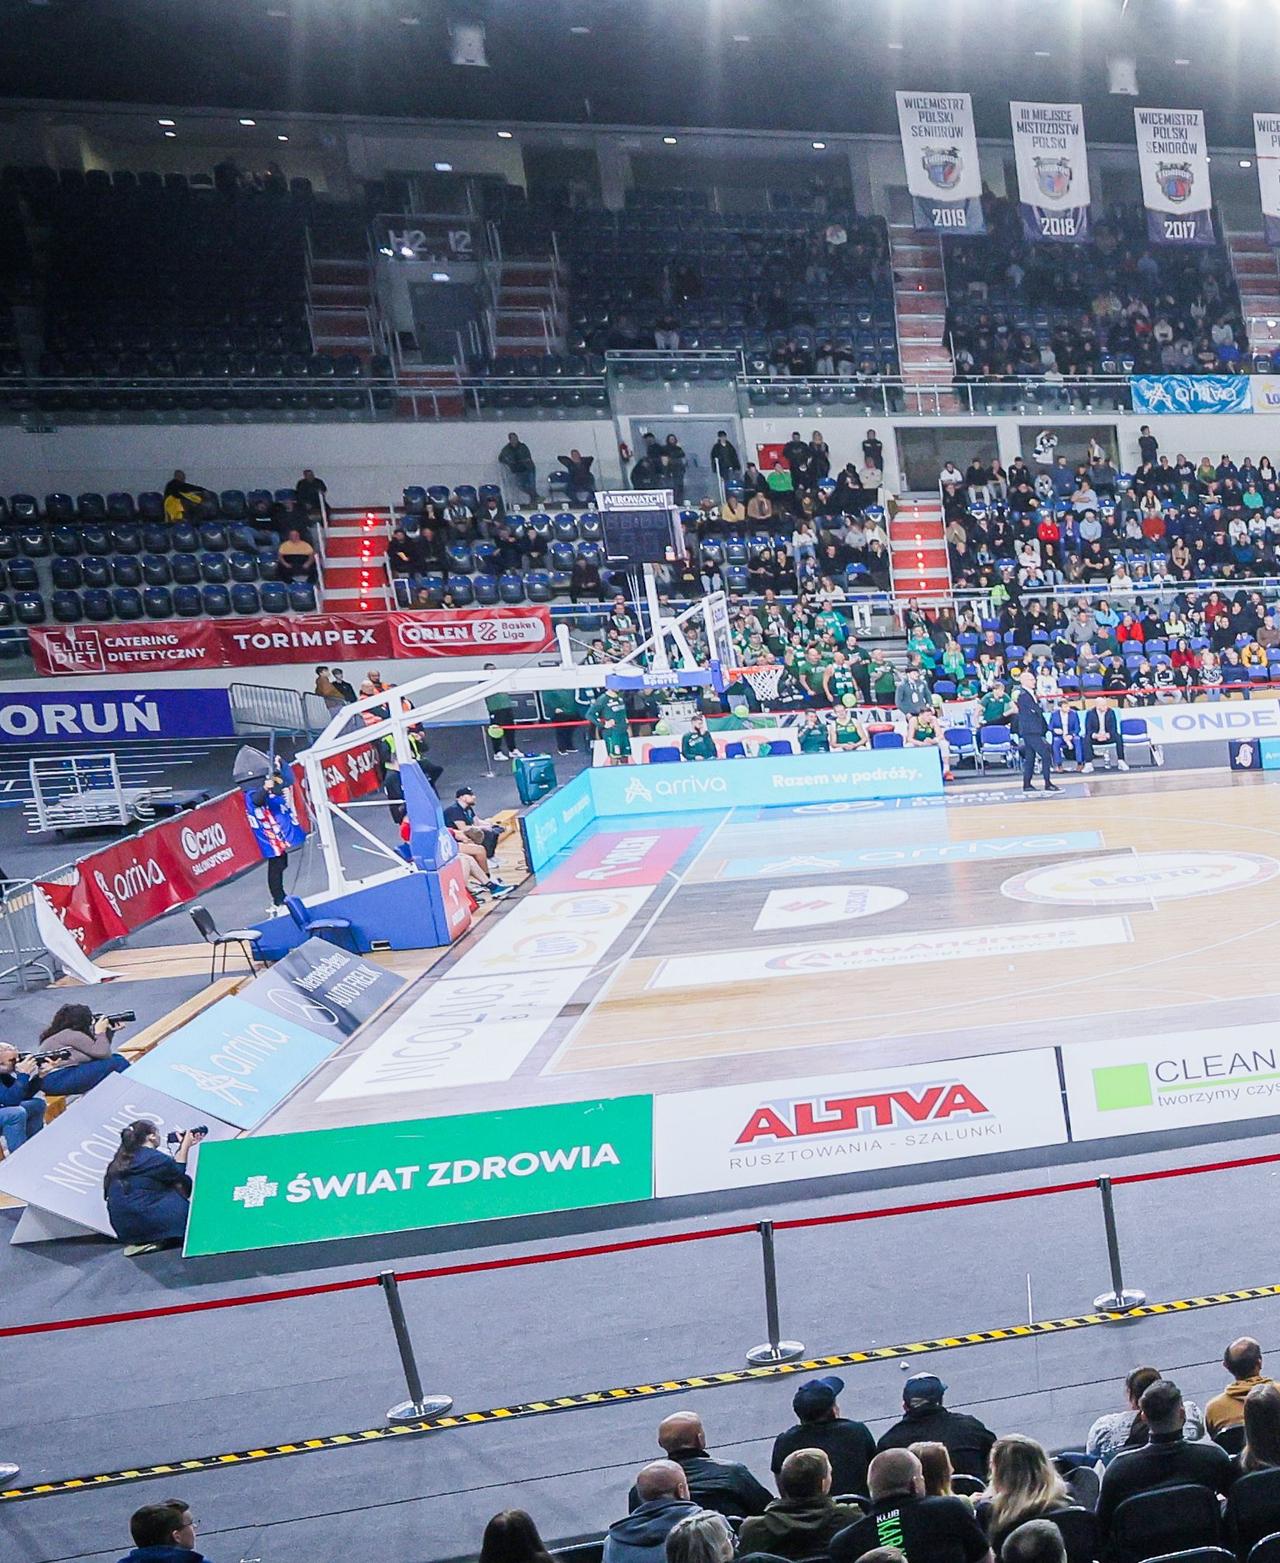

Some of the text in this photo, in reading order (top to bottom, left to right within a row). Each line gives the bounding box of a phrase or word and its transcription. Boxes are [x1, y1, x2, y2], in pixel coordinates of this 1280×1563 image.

[904, 98, 965, 110] WICEMISTRZ
[919, 110, 954, 123] POLSKI
[1021, 109, 1072, 121] III MIEJSCE
[1139, 112, 1199, 126] WICEMISTRZ
[1153, 126, 1188, 140] POLSKI
[1032, 136, 1067, 149] POLSKI
[1146, 140, 1198, 155] SENIORÓW
[932, 208, 966, 227] 2019
[1040, 217, 1077, 235] 2018
[1164, 221, 1196, 239] 2017
[405, 626, 469, 642] ORLEN
[501, 622, 537, 632] Basket
[502, 631, 525, 639] Liga
[52, 640, 96, 653] ELITE
[104, 634, 179, 648] CATERING
[233, 628, 377, 650] TORIMPEX
[54, 651, 97, 664] DIET
[107, 647, 206, 663] DIETETYCZNY
[0, 694, 161, 736] ORUŃ
[1171, 709, 1278, 732] ONDE
[655, 768, 922, 796] arriva Razem w podróży.
[857, 837, 1068, 863] arriva
[114, 857, 167, 902] arriva
[1088, 866, 1201, 888] LOTTO
[365, 982, 515, 1084] NICOLAUS
[213, 1022, 292, 1076] arriva
[1155, 1048, 1276, 1083] CLEAN
[1158, 1086, 1241, 1107] tworzymy
[735, 1083, 991, 1145] ALTIVA
[728, 1138, 884, 1170] RUSZTOWANIA
[904, 1123, 1004, 1147] SZALUNKI
[285, 1142, 620, 1204] ŚWIAT ZDROWIA
